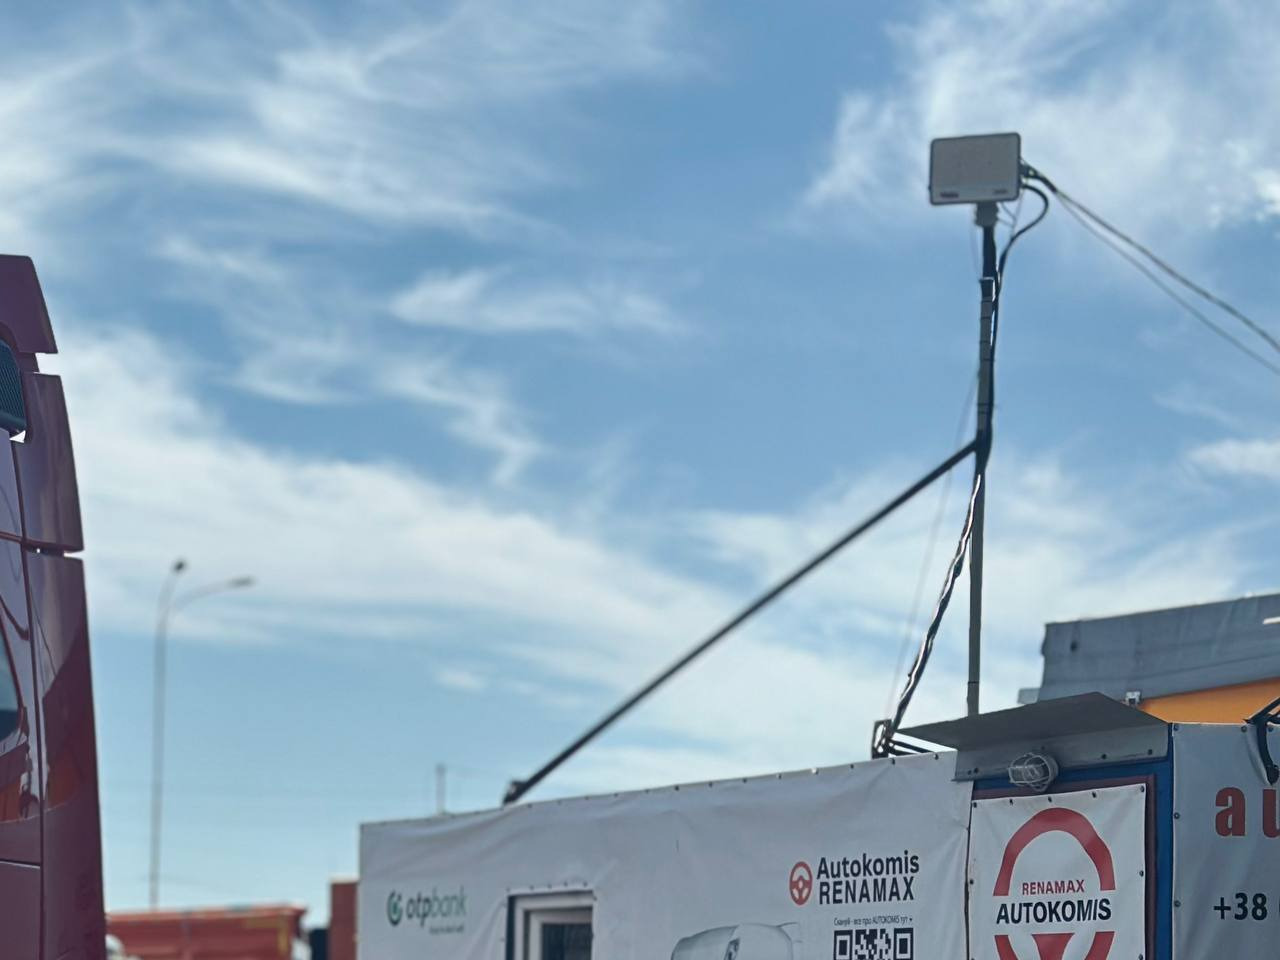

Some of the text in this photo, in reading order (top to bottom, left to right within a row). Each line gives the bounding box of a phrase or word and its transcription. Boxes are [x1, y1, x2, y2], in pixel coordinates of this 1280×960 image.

[817, 850, 920, 880] Autokomis
[819, 876, 914, 905] RENAMAX
[1022, 879, 1085, 896] RENAMAX
[996, 898, 1112, 925] AUTOKOMIS
[1213, 892, 1268, 921] +38
